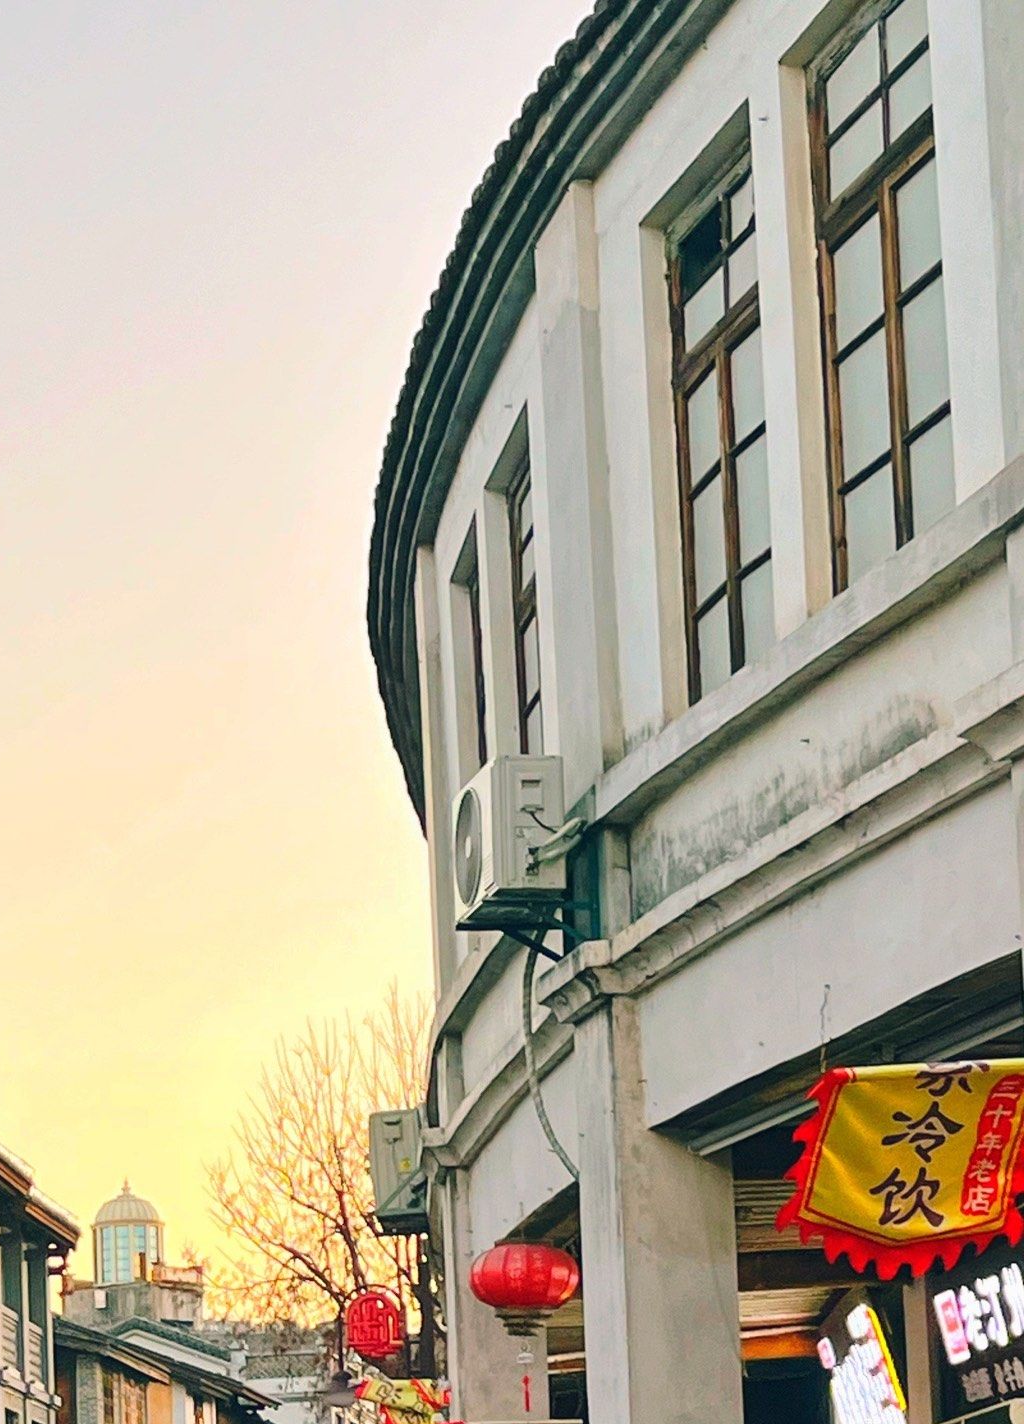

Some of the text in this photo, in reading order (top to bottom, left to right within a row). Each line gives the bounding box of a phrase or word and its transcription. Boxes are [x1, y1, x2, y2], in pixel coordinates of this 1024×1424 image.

[962, 1079, 1023, 1213] 三十年老店
